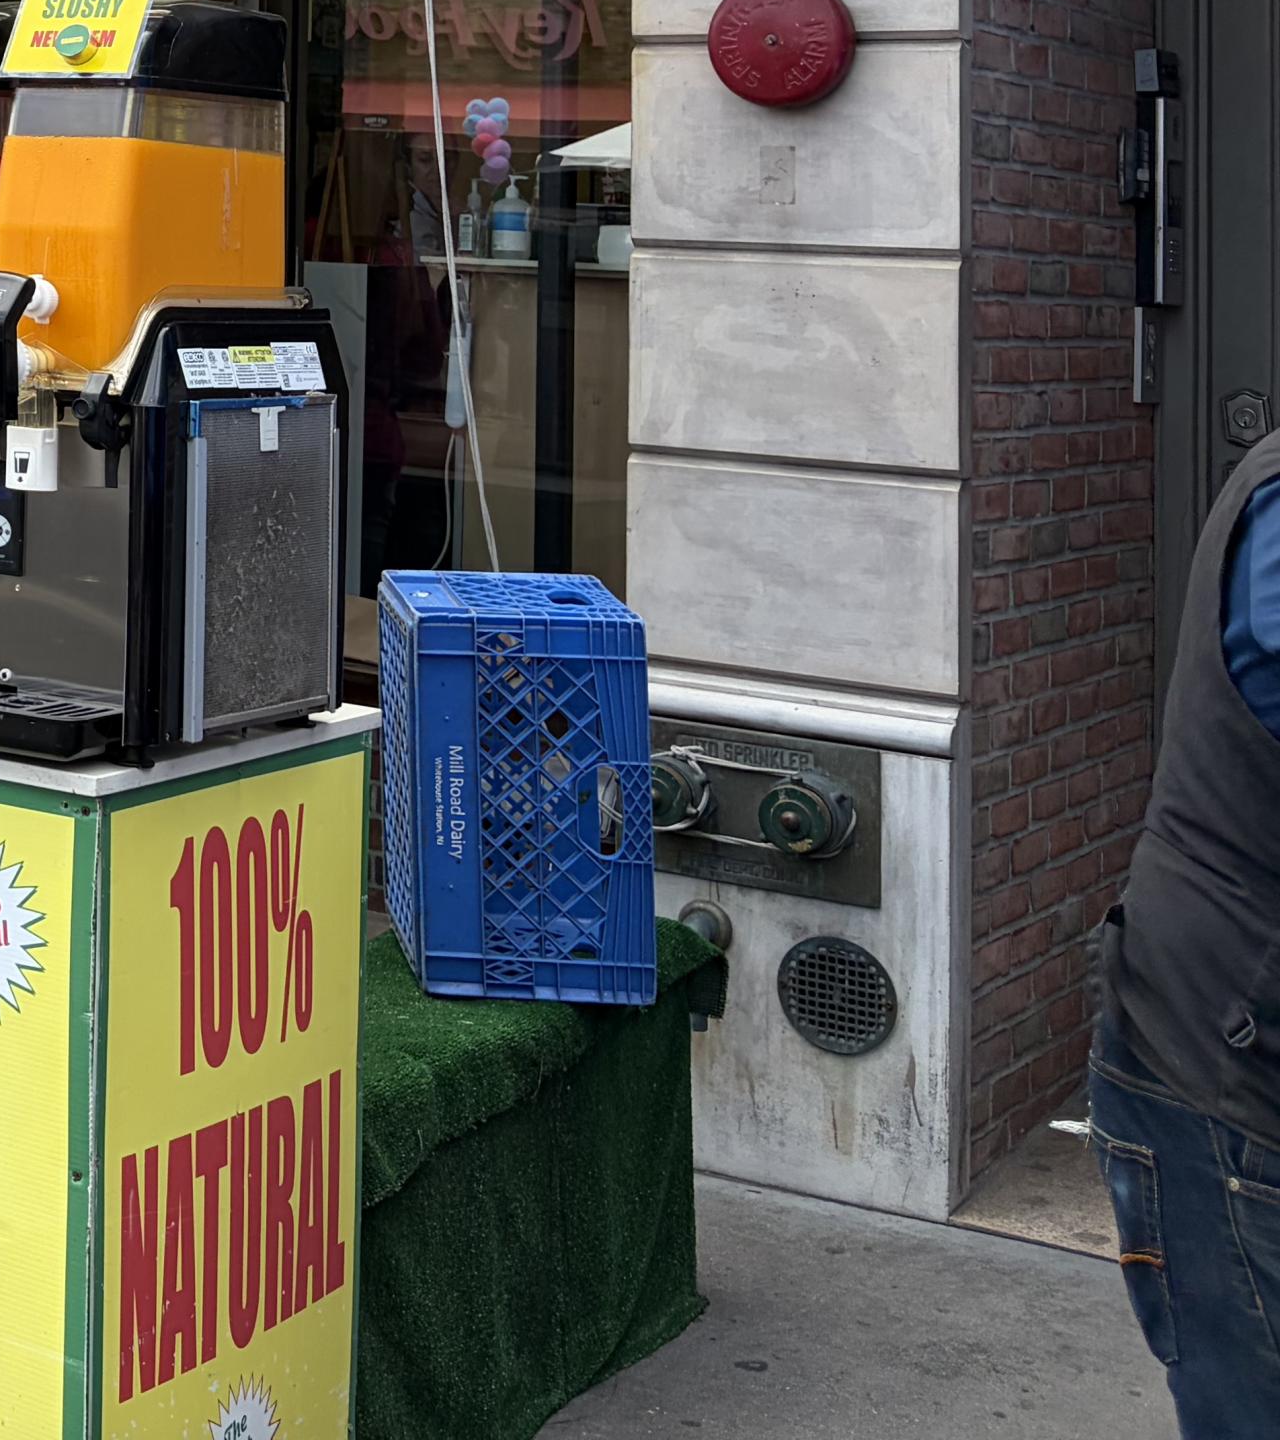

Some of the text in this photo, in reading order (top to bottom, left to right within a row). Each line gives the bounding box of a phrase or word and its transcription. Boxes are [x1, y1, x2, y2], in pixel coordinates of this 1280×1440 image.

[783, 21, 829, 90] ALARM
[448, 745, 466, 859] Mill Road Dairy
[168, 802, 315, 1077] 100%
[118, 1067, 346, 1405] NATURAL
